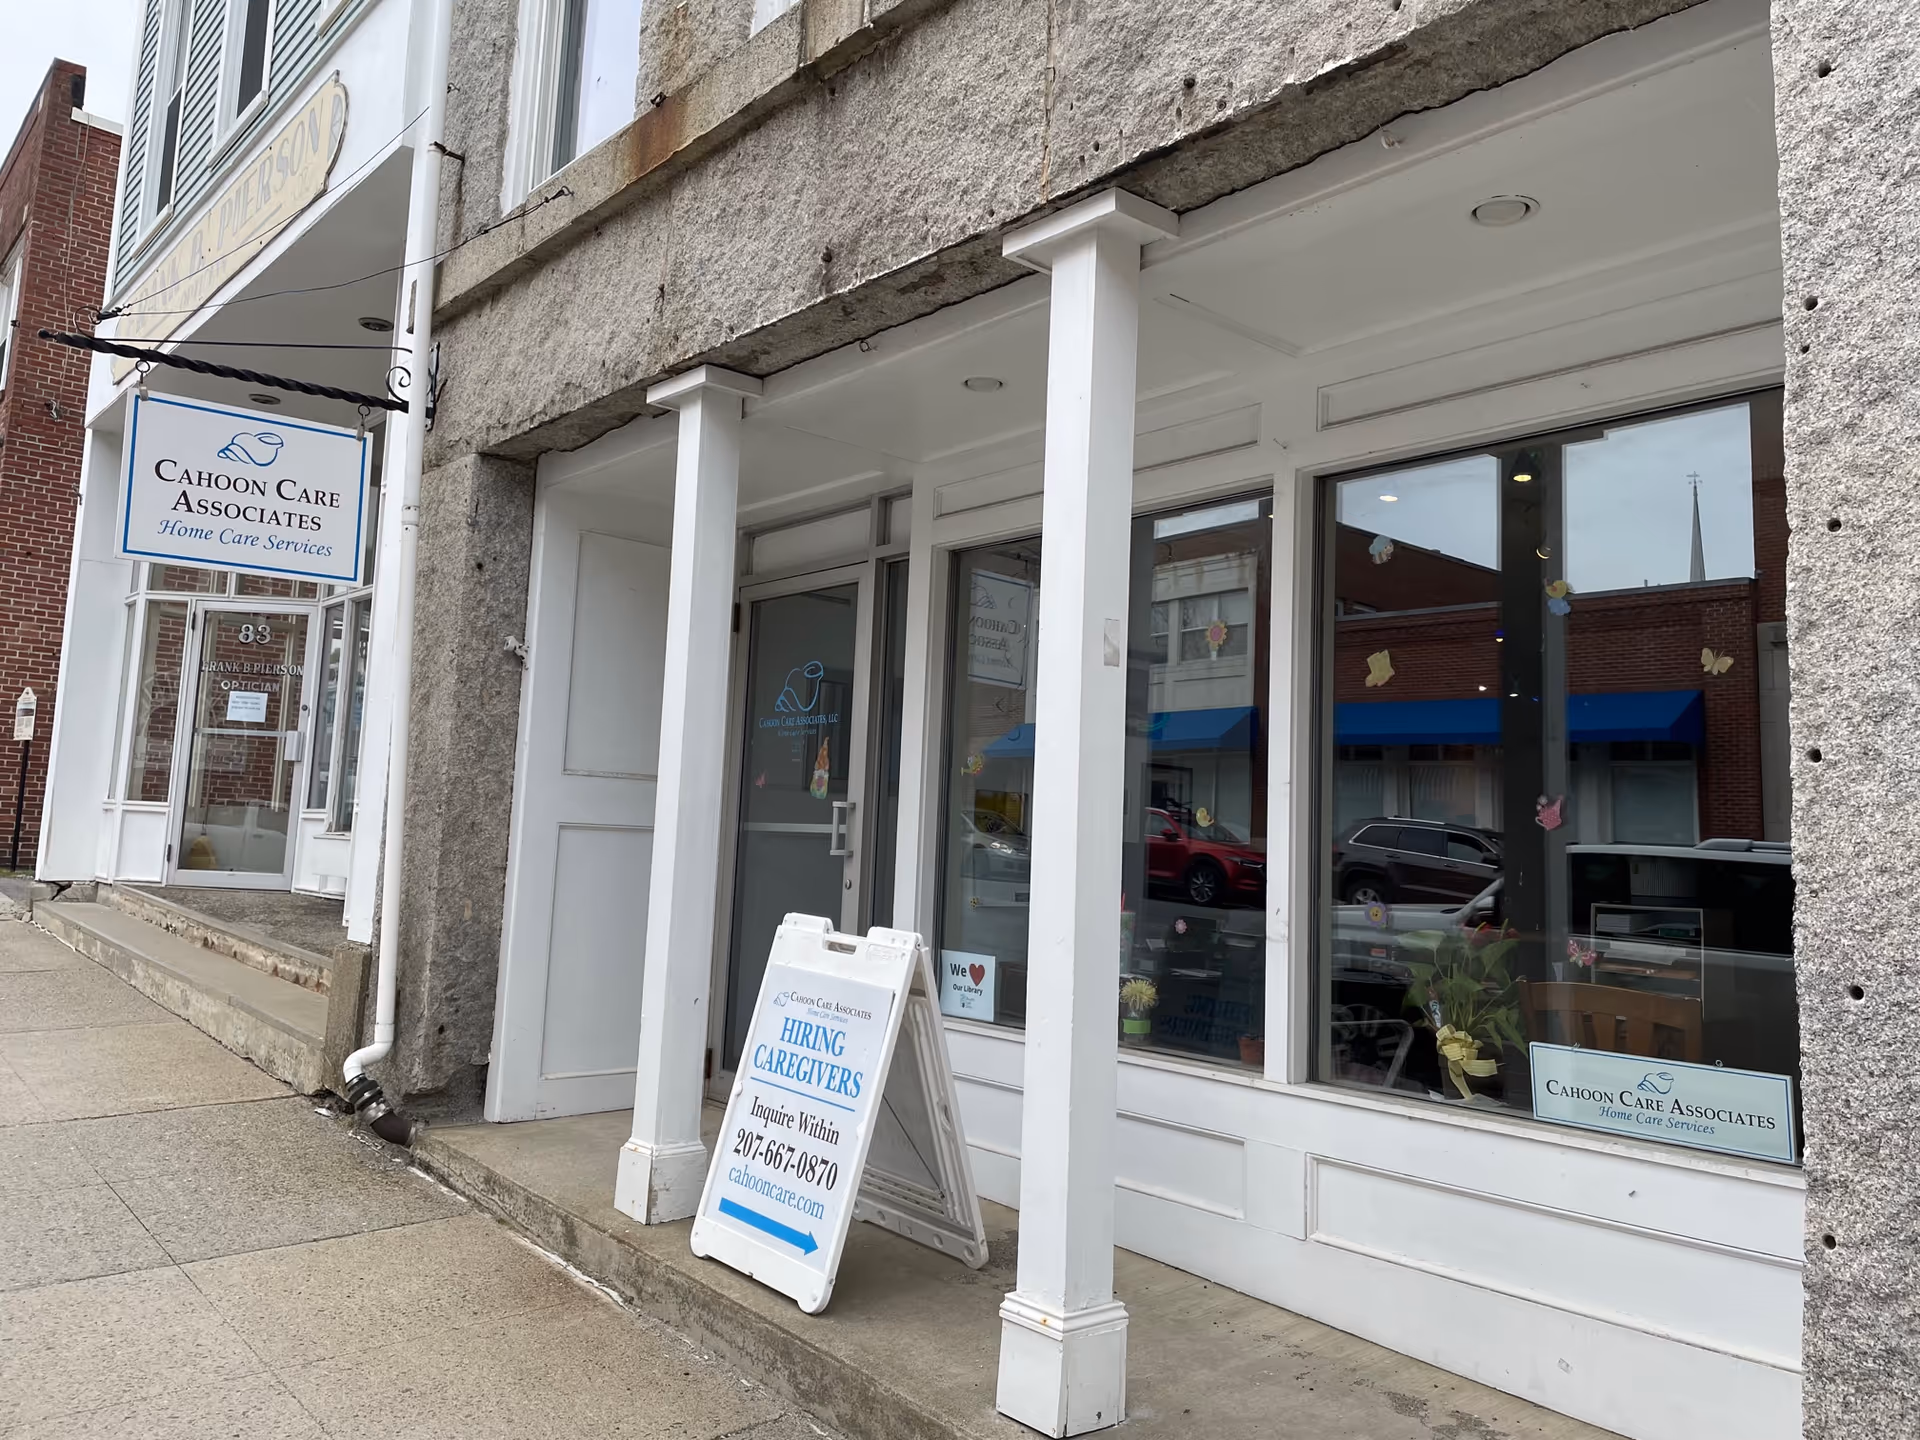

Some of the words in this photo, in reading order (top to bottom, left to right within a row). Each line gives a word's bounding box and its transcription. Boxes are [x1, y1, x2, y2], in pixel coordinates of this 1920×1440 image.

[217, 97, 324, 251] PIERSON
[154, 458, 268, 498] CAHOON
[275, 478, 341, 509] CARE
[170, 489, 322, 532] ASSOCIATES
[157, 519, 214, 541] Home
[219, 527, 260, 547] Care
[263, 534, 333, 558] Services
[238, 623, 272, 644] 83
[201, 660, 240, 673] FRANK
[253, 662, 304, 676] PIERSON
[221, 680, 280, 692] OPTICIAN
[828, 712, 839, 723] LLC
[949, 962, 967, 977] We
[953, 983, 963, 991] Our
[964, 984, 983, 996] Library
[790, 991, 816, 1007] CAHOON
[816, 997, 833, 1011] CARE
[833, 1001, 872, 1020] ASSOCIATES
[779, 1016, 846, 1057] HIRING
[753, 1044, 863, 1099] CAREGIVERS
[750, 1096, 795, 1129] Inquire
[797, 1110, 840, 1145] Within
[1546, 1080, 1614, 1105] CAHOON
[1619, 1090, 1665, 1112] CARE
[1670, 1098, 1776, 1130] ASSOCIATES
[1599, 1106, 1633, 1121] Home
[1636, 1111, 1663, 1127] Care
[1665, 1117, 1715, 1135] Services
[732, 1128, 838, 1191] 207-667-0870
[728, 1165, 825, 1220] cahooncare.com
